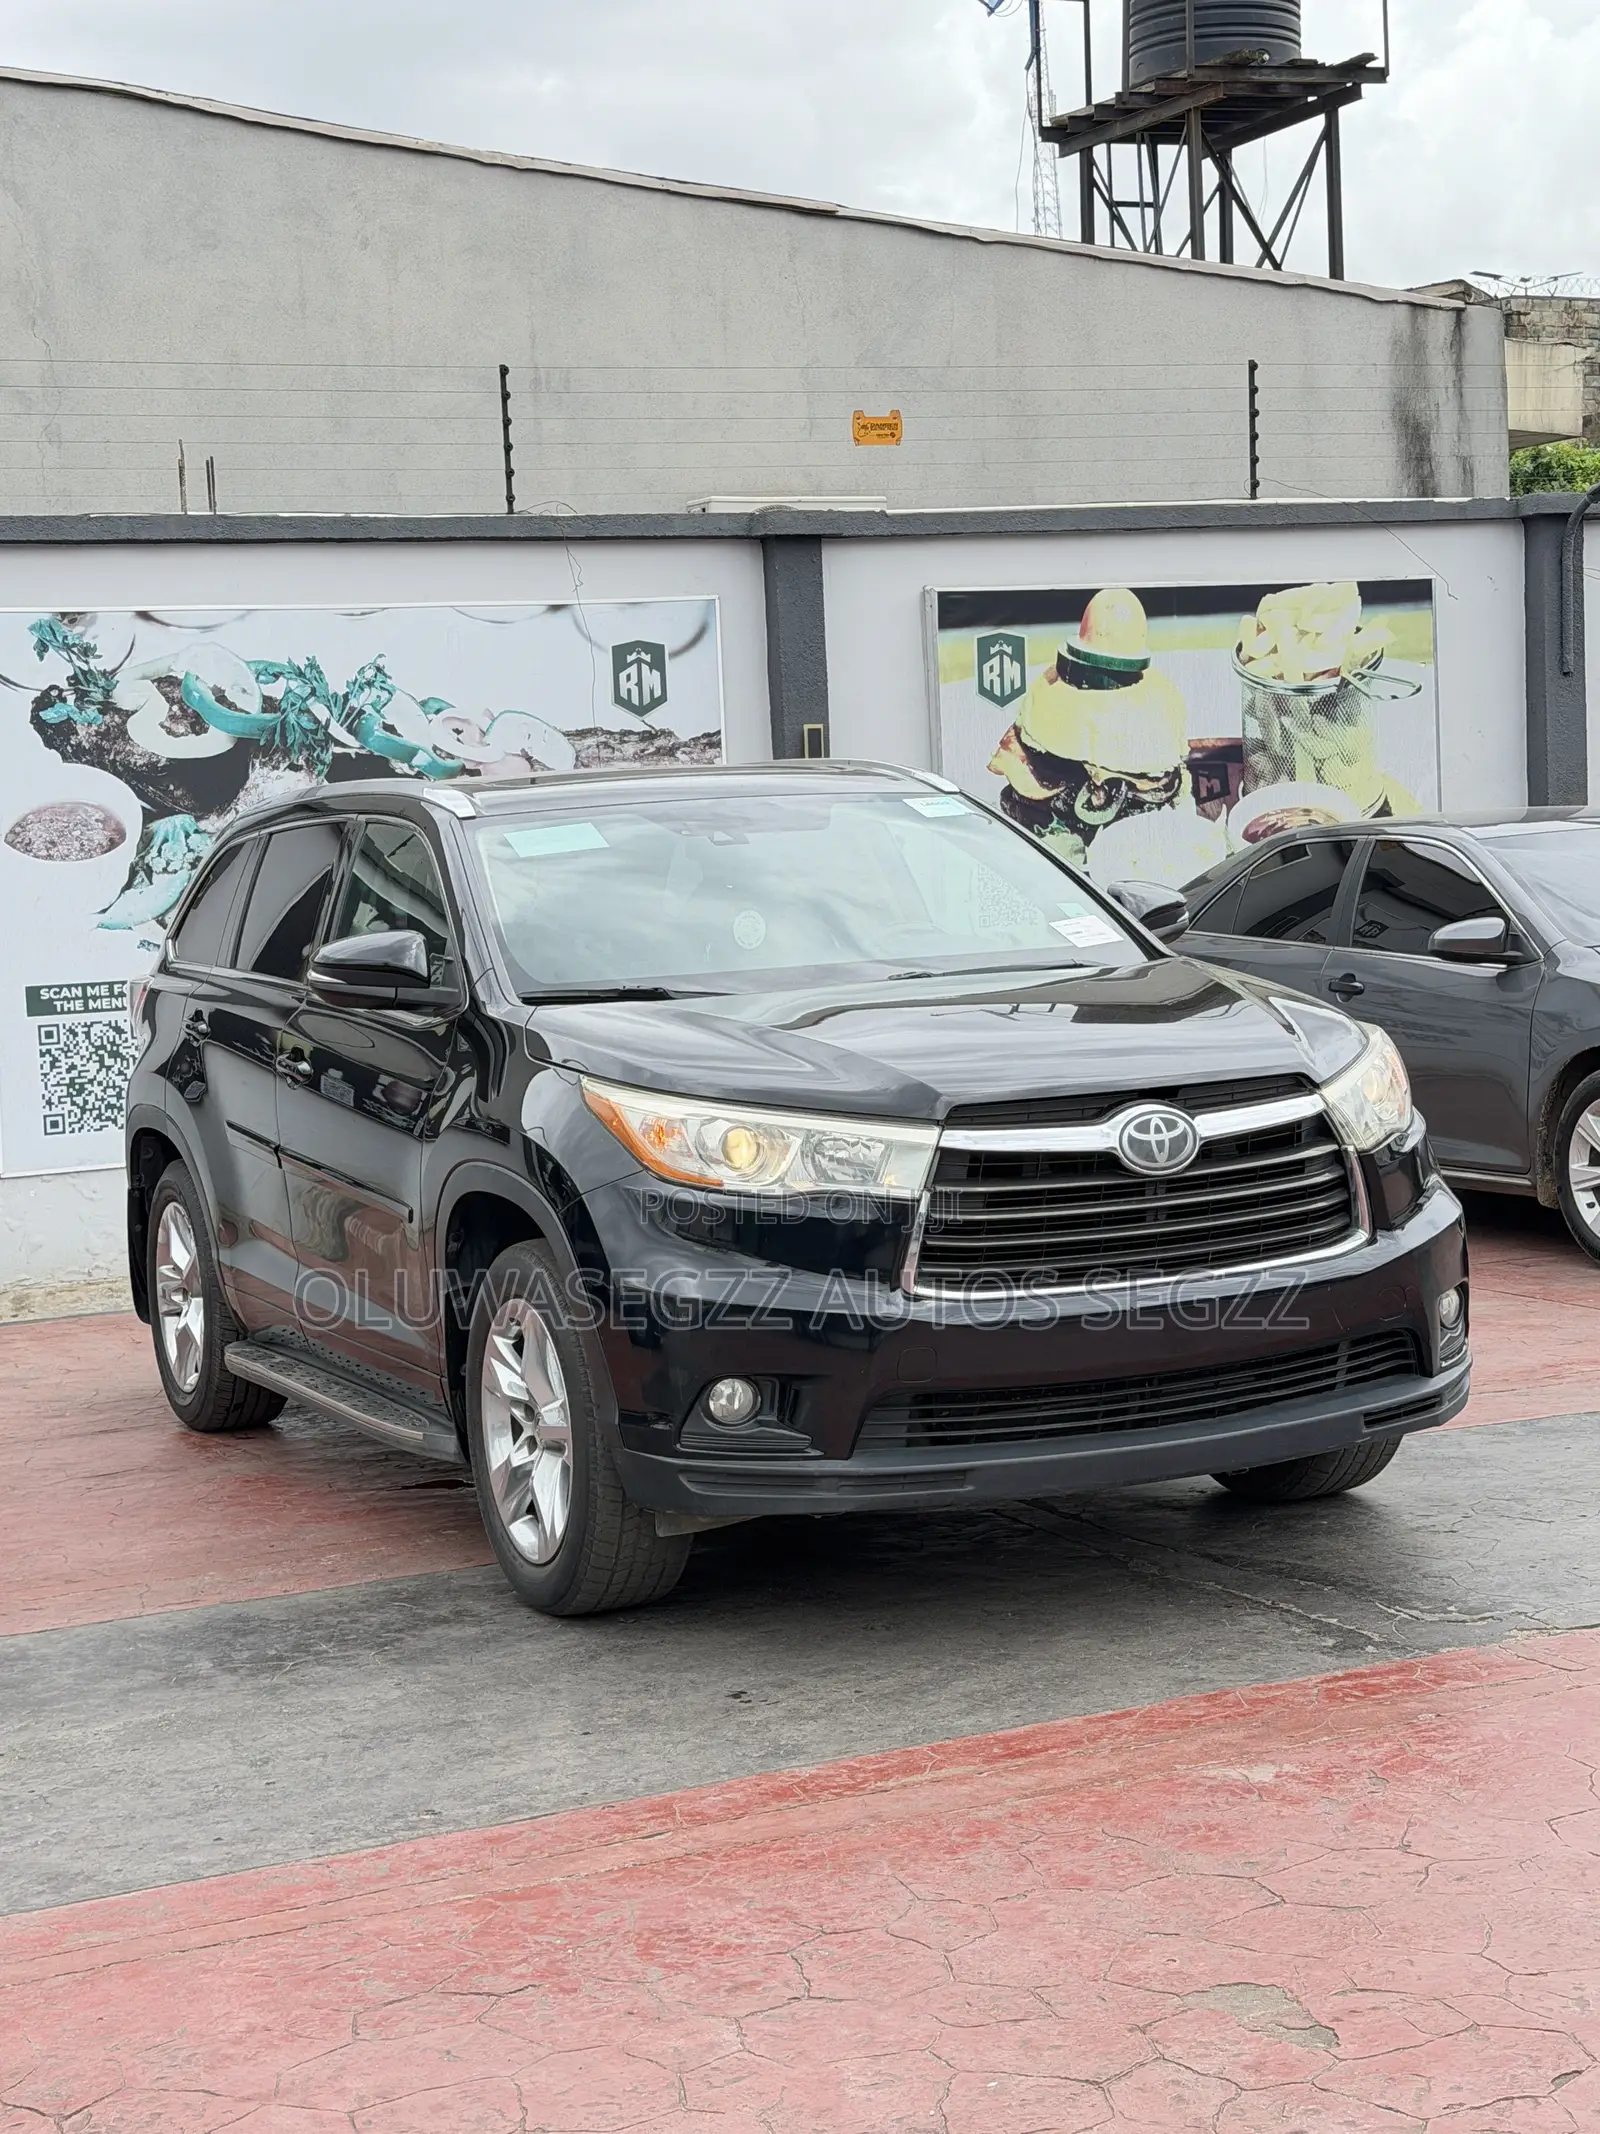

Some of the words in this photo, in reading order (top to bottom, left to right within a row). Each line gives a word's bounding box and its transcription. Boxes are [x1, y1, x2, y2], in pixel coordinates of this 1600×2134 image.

[619, 662, 662, 706] RM
[983, 654, 1021, 697] RM
[40, 986, 83, 1000] SCAN
[86, 984, 110, 997] ME
[53, 999, 84, 1012] THE
